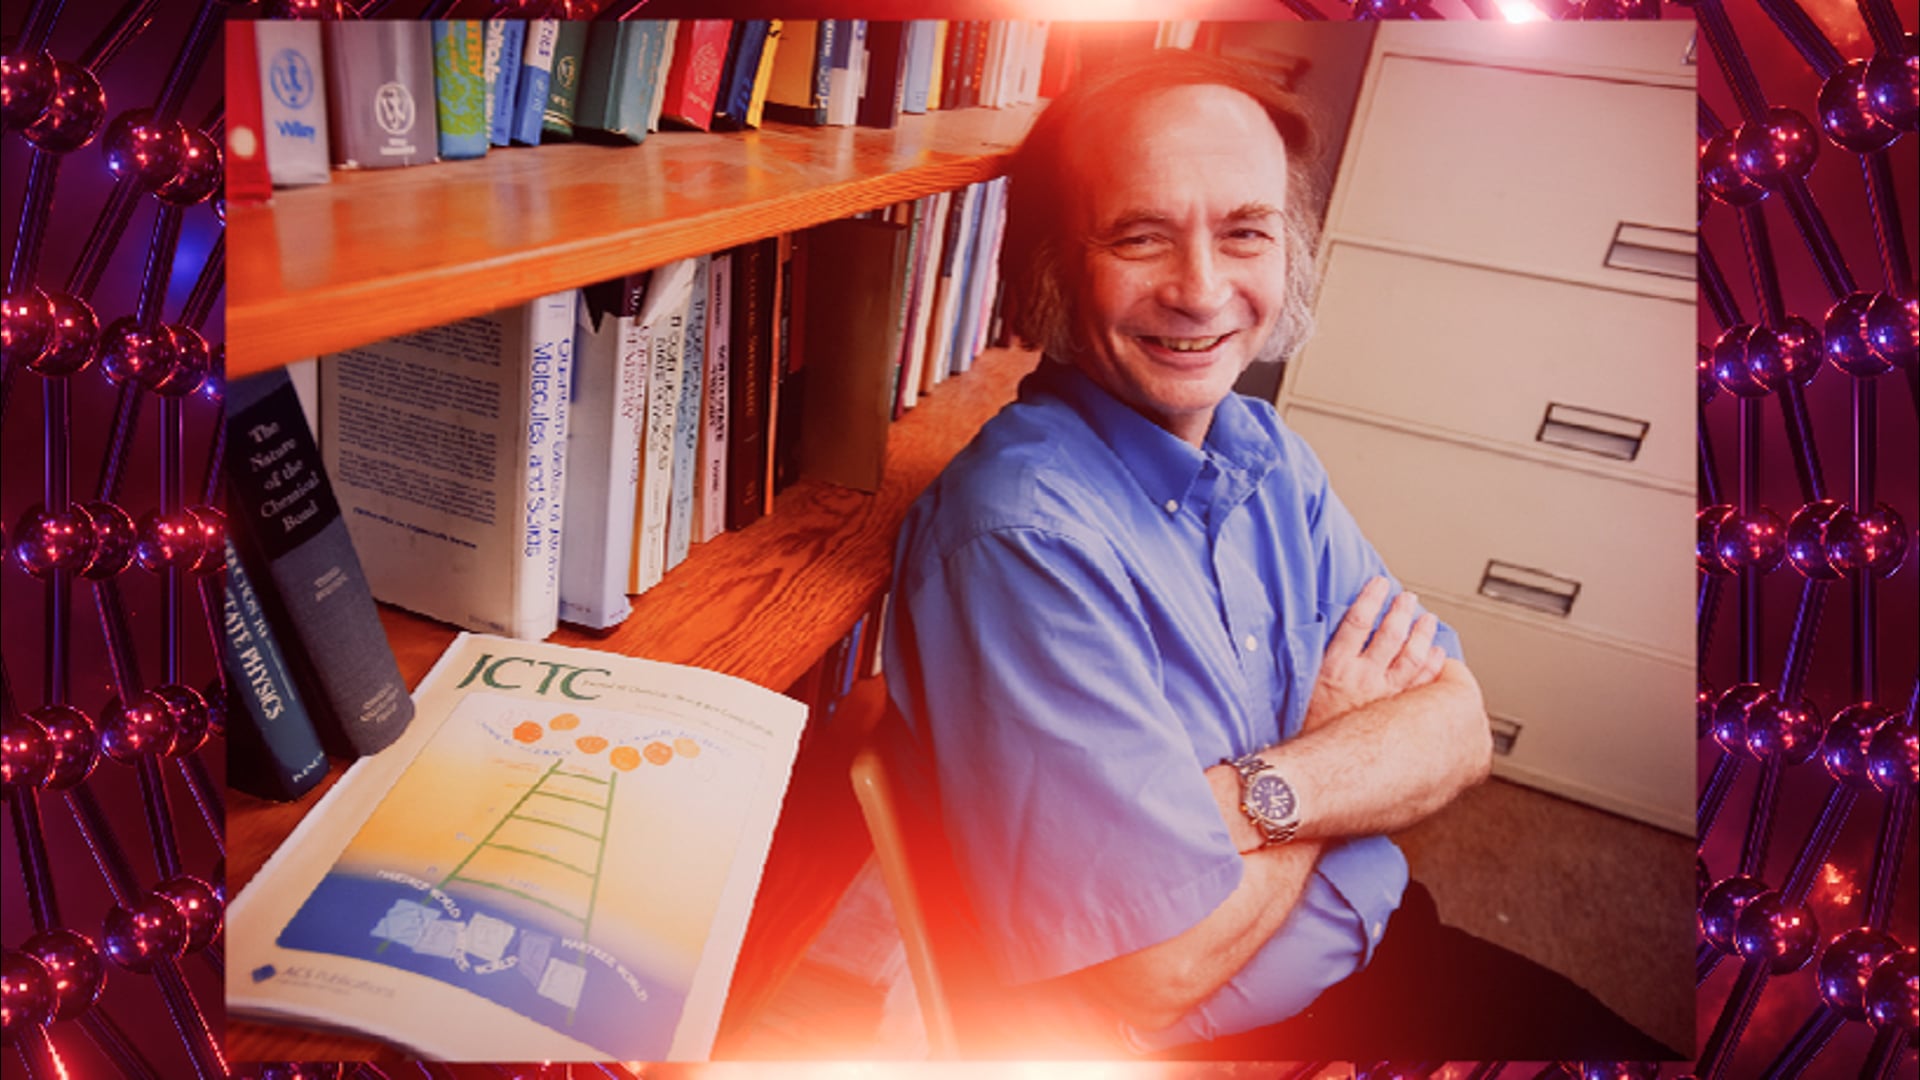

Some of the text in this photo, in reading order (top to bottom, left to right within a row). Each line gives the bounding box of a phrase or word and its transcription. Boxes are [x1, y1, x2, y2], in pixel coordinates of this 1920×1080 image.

[248, 421, 279, 442] The
[525, 341, 552, 558] Molecules, and Solids
[250, 438, 297, 472] Nature
[263, 459, 303, 490] of the
[261, 470, 320, 518] Chemical
[282, 500, 319, 532] Bond
[240, 646, 285, 720] PHYSICS
[456, 653, 612, 700] JCTC
